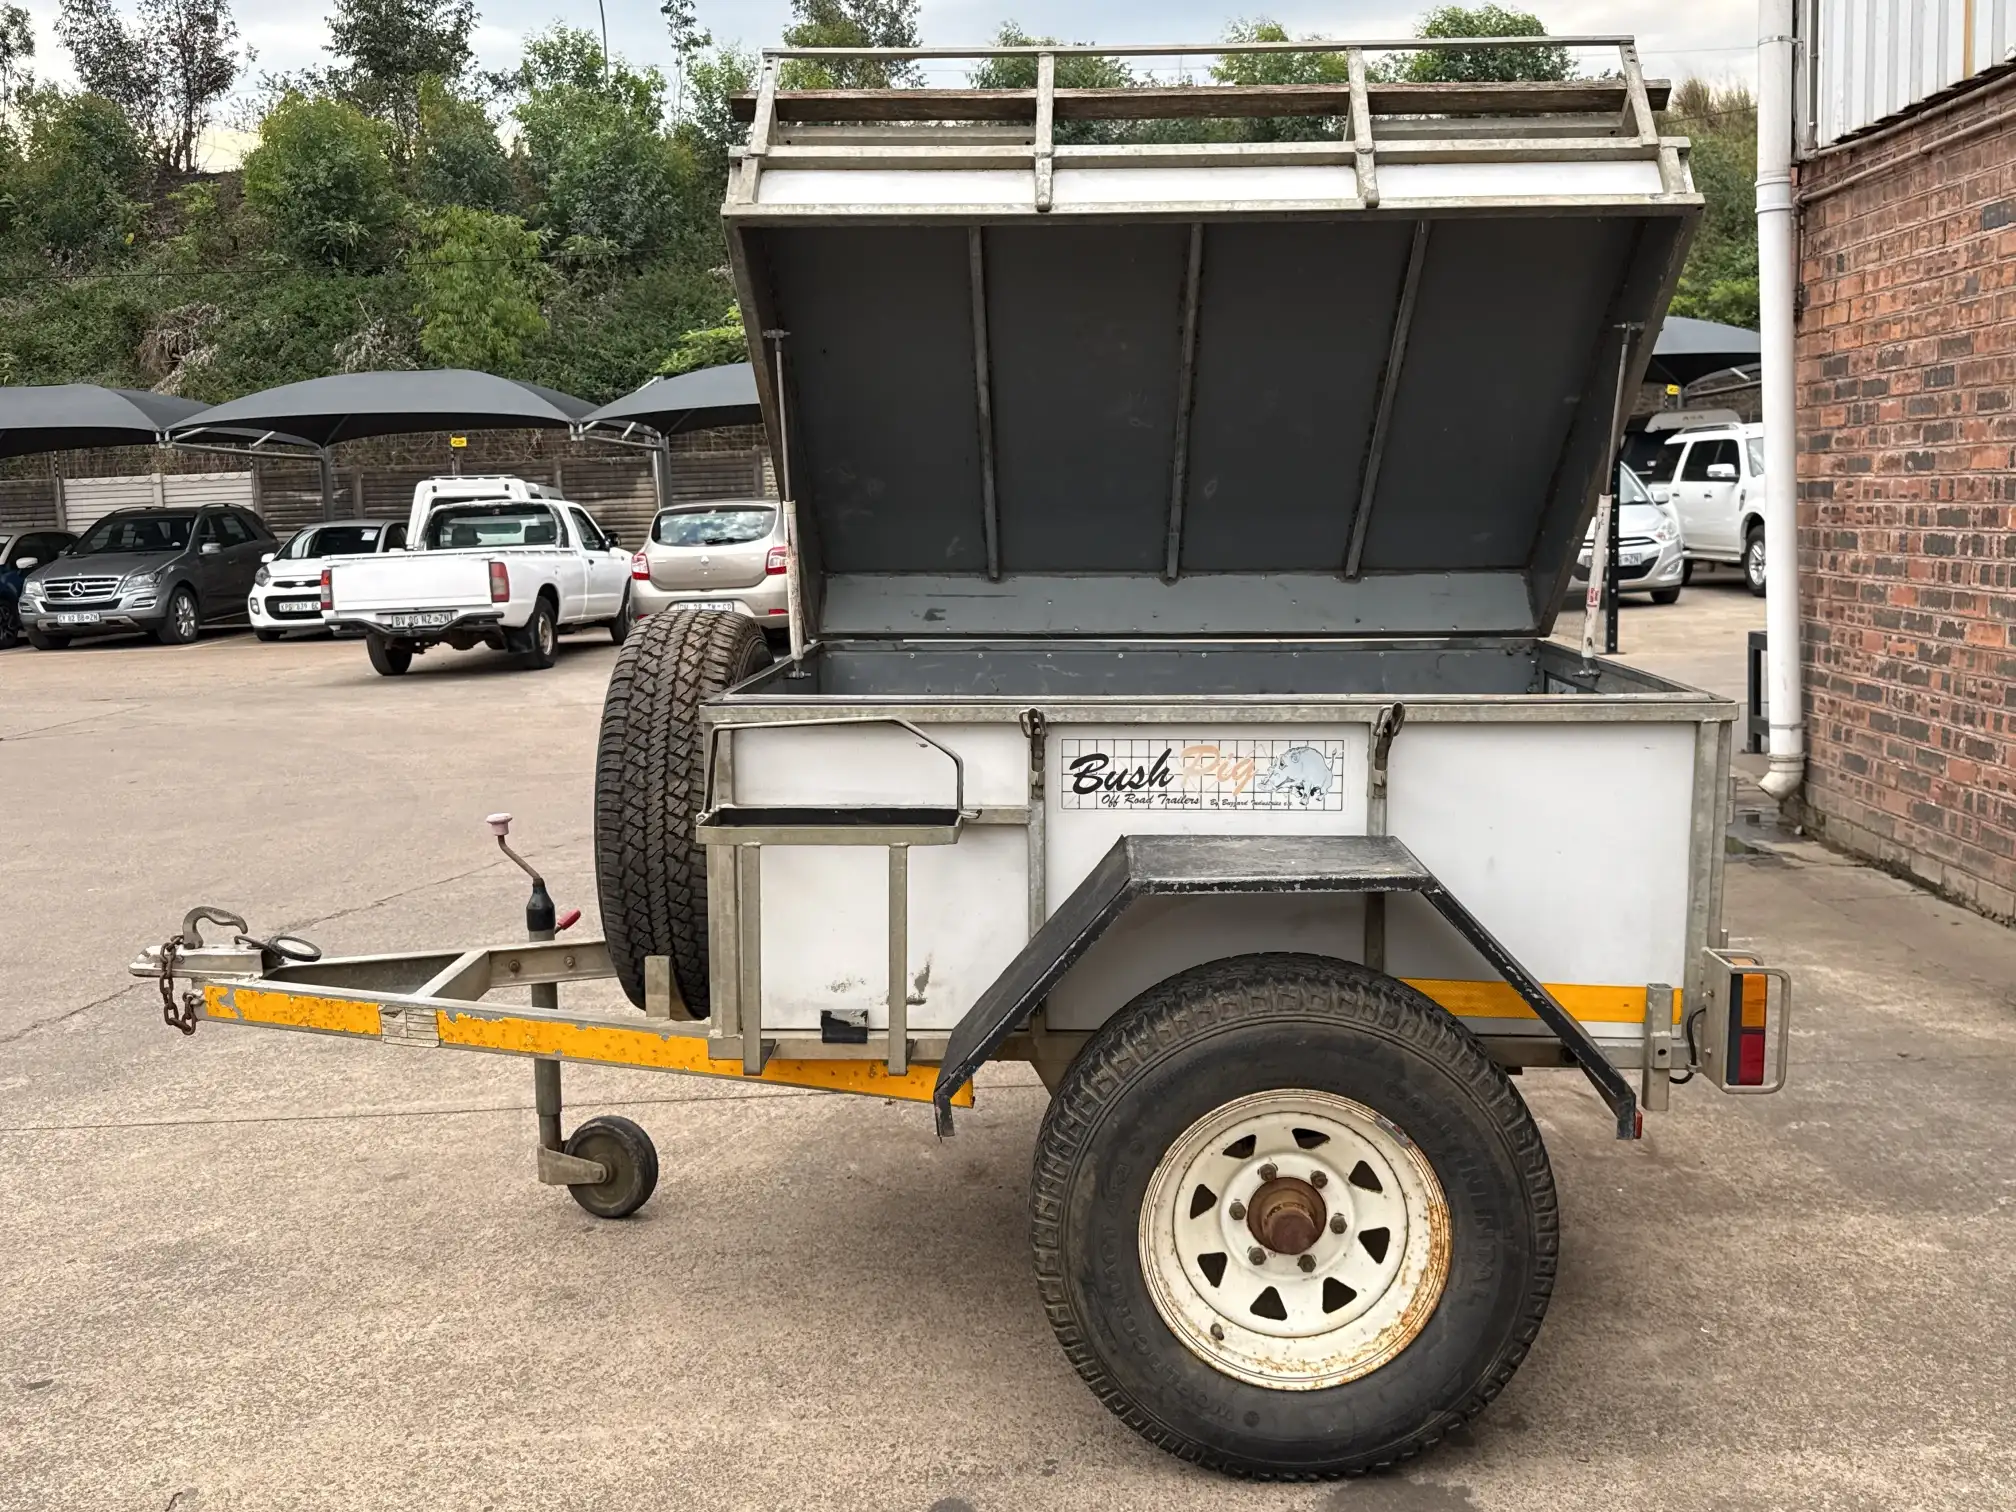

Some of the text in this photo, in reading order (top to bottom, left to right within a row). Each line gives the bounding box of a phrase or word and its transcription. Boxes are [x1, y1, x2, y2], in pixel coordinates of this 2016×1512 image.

[1069, 745, 1256, 796] Bush Pig
[1101, 793, 1201, 808] Off Road Trailers
